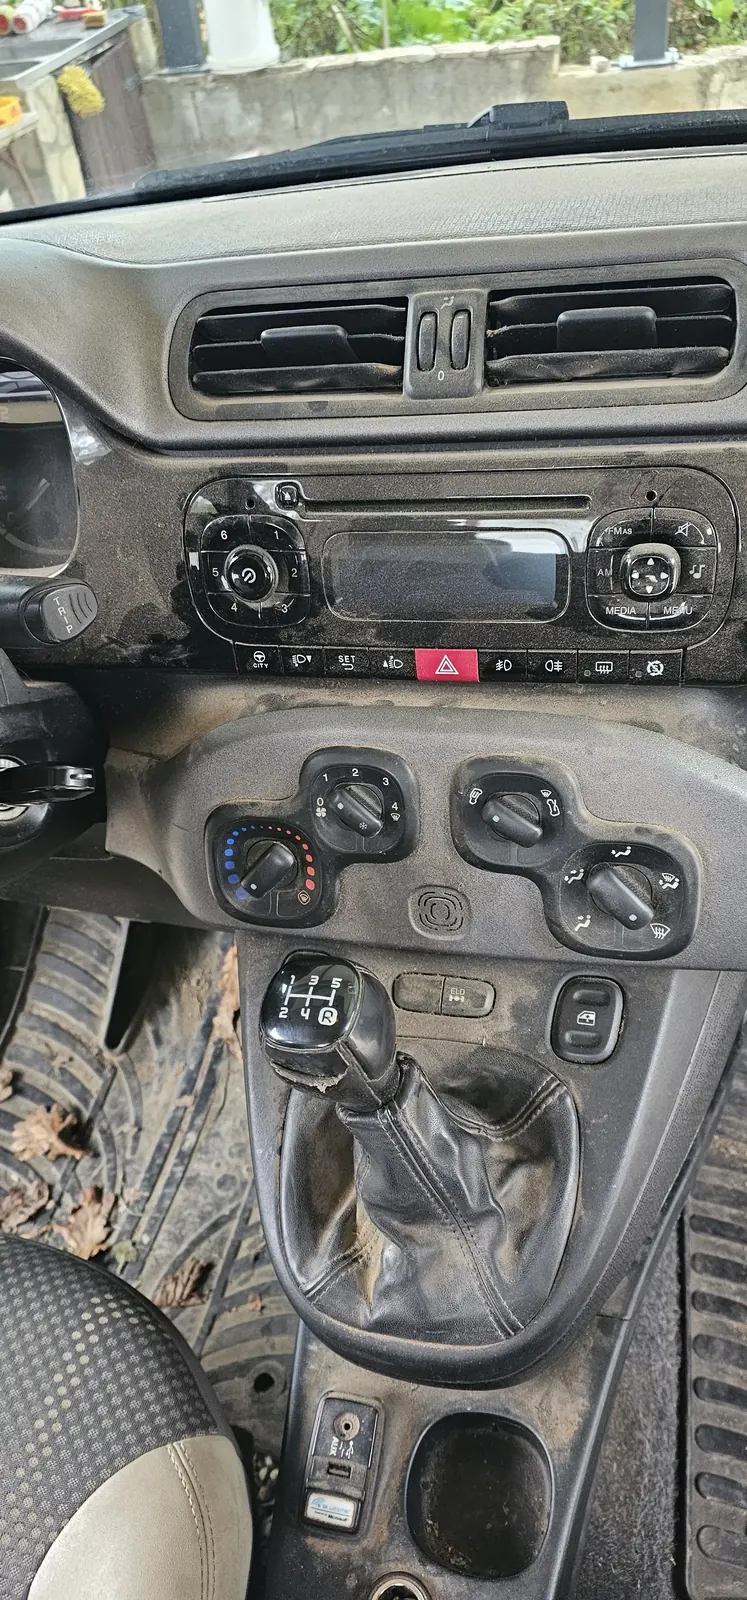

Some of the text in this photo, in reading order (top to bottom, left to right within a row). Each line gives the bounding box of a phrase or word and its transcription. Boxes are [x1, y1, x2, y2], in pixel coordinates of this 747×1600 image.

[438, 370, 445, 380] 0
[220, 530, 228, 540] 6
[274, 530, 280, 540] 1
[212, 568, 219, 577] 5
[291, 568, 298, 578] 2
[230, 603, 238, 612] 4
[281, 604, 288, 613] 3
[605, 606, 637, 615] MEDIA
[663, 606, 693, 615] MENU
[53, 596, 73, 633] TRIP
[338, 655, 356, 663] SET
[351, 768, 359, 777] 2
[322, 773, 329, 782] 1
[382, 777, 389, 786] 3
[316, 797, 324, 806] 0
[391, 802, 398, 811] 4
[290, 975, 296, 985] 1
[308, 975, 319, 986] 3
[331, 977, 342, 989] 5
[278, 1007, 288, 1018] 2
[300, 1008, 310, 1020] 4
[329, 1436, 339, 1456] AUX
